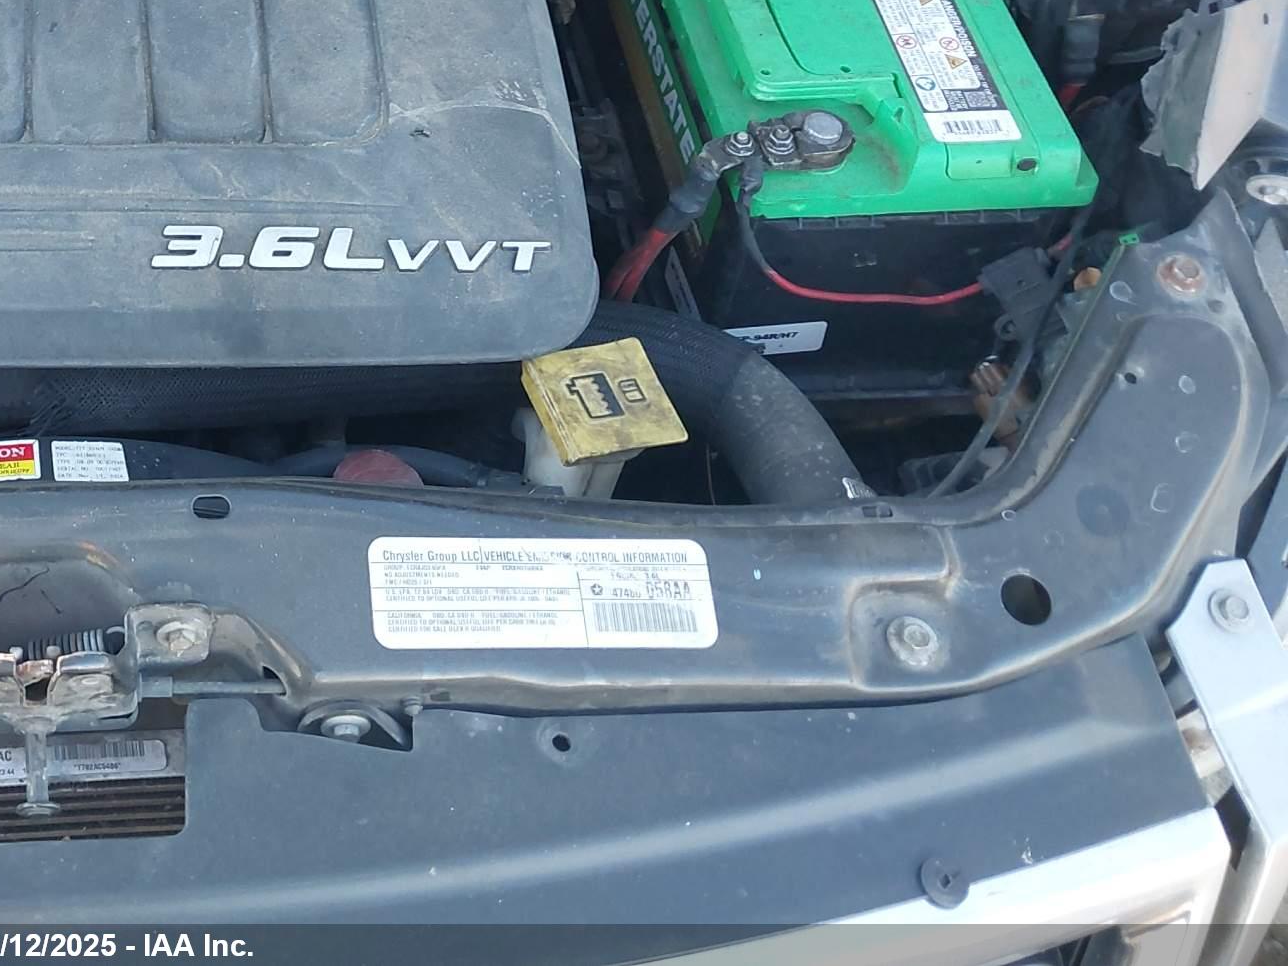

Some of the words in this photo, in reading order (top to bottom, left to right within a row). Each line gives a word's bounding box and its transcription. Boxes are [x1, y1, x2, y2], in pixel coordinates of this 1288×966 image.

[383, 549, 423, 563] Chrysler
[427, 549, 458, 563] Group
[461, 550, 481, 562] LLC
[483, 550, 523, 562] VEHICLE
[623, 551, 688, 563] INFORMATION
